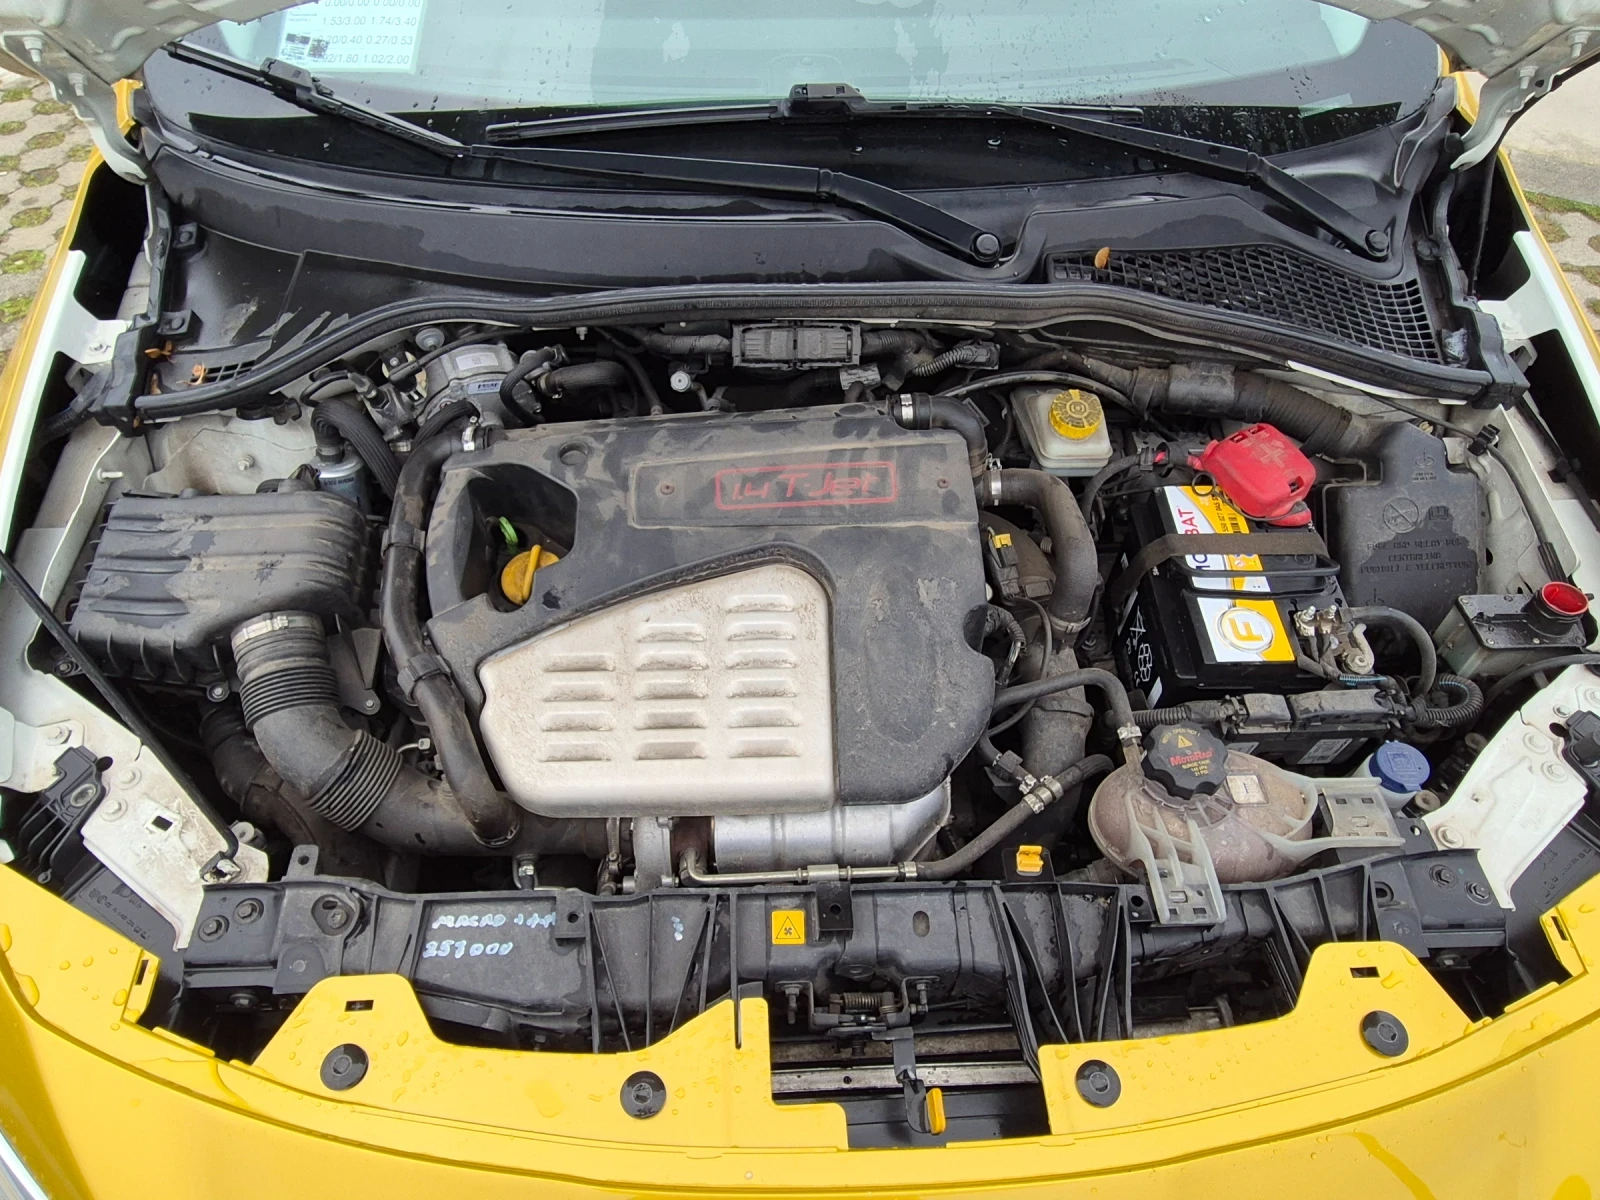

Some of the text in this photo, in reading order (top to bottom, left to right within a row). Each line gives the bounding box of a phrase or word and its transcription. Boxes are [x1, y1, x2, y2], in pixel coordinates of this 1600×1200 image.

[322, 16, 367, 26] 1.53/3.00
[371, 16, 417, 26] 1.74/3.40
[366, 36, 413, 45] 0.27/0.53
[363, 54, 409, 64] 1.02/2.00
[732, 480, 771, 500] 1.4
